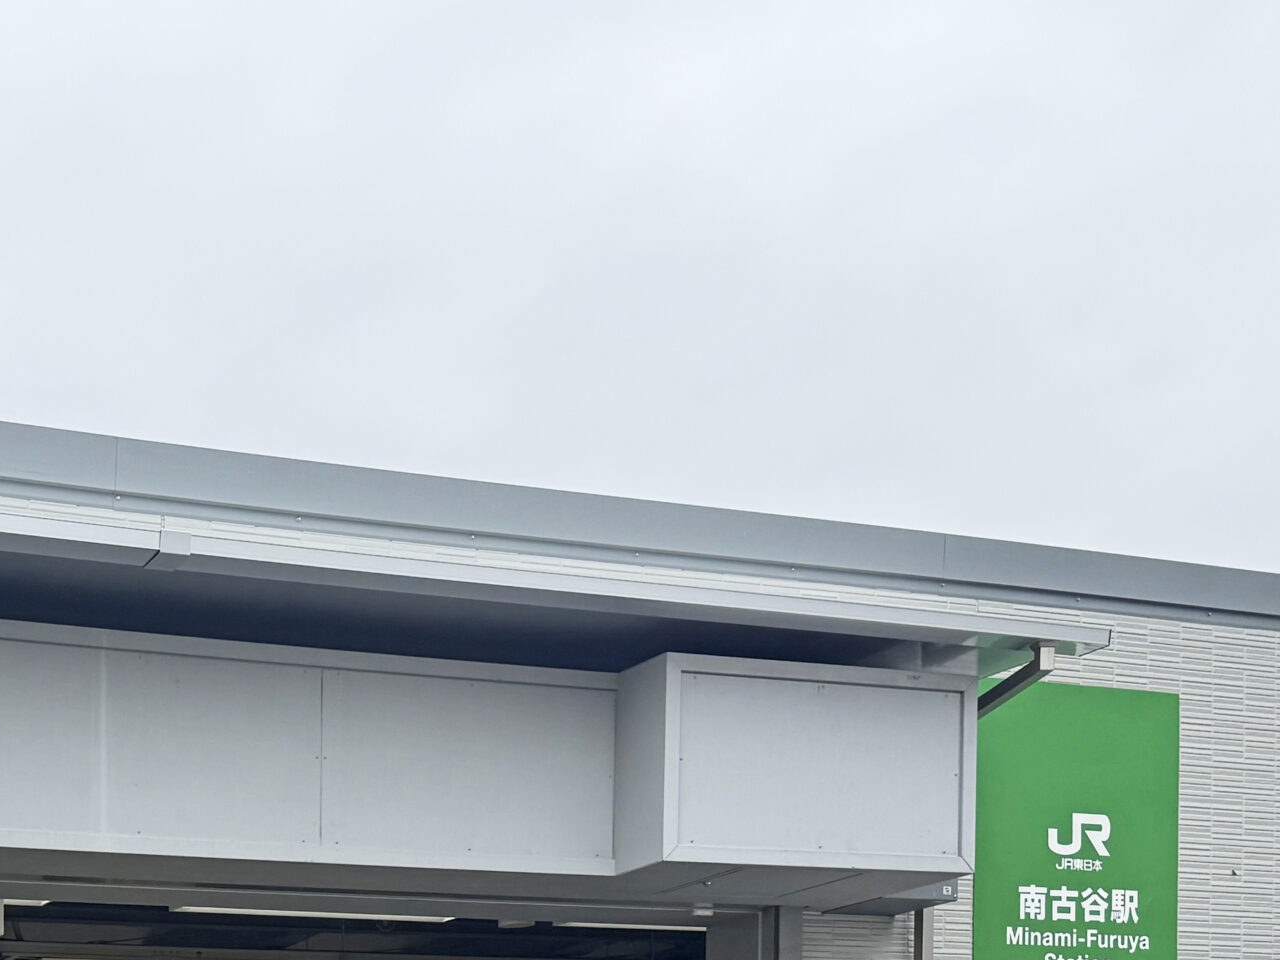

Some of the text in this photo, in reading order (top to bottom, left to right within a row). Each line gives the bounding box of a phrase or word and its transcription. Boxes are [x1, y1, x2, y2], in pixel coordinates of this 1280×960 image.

[1048, 812, 1111, 856] JR
[1056, 857, 1103, 872] JR東日本
[1018, 884, 1139, 924] 南古谷駅
[1006, 926, 1150, 953] Minami-Furuya
